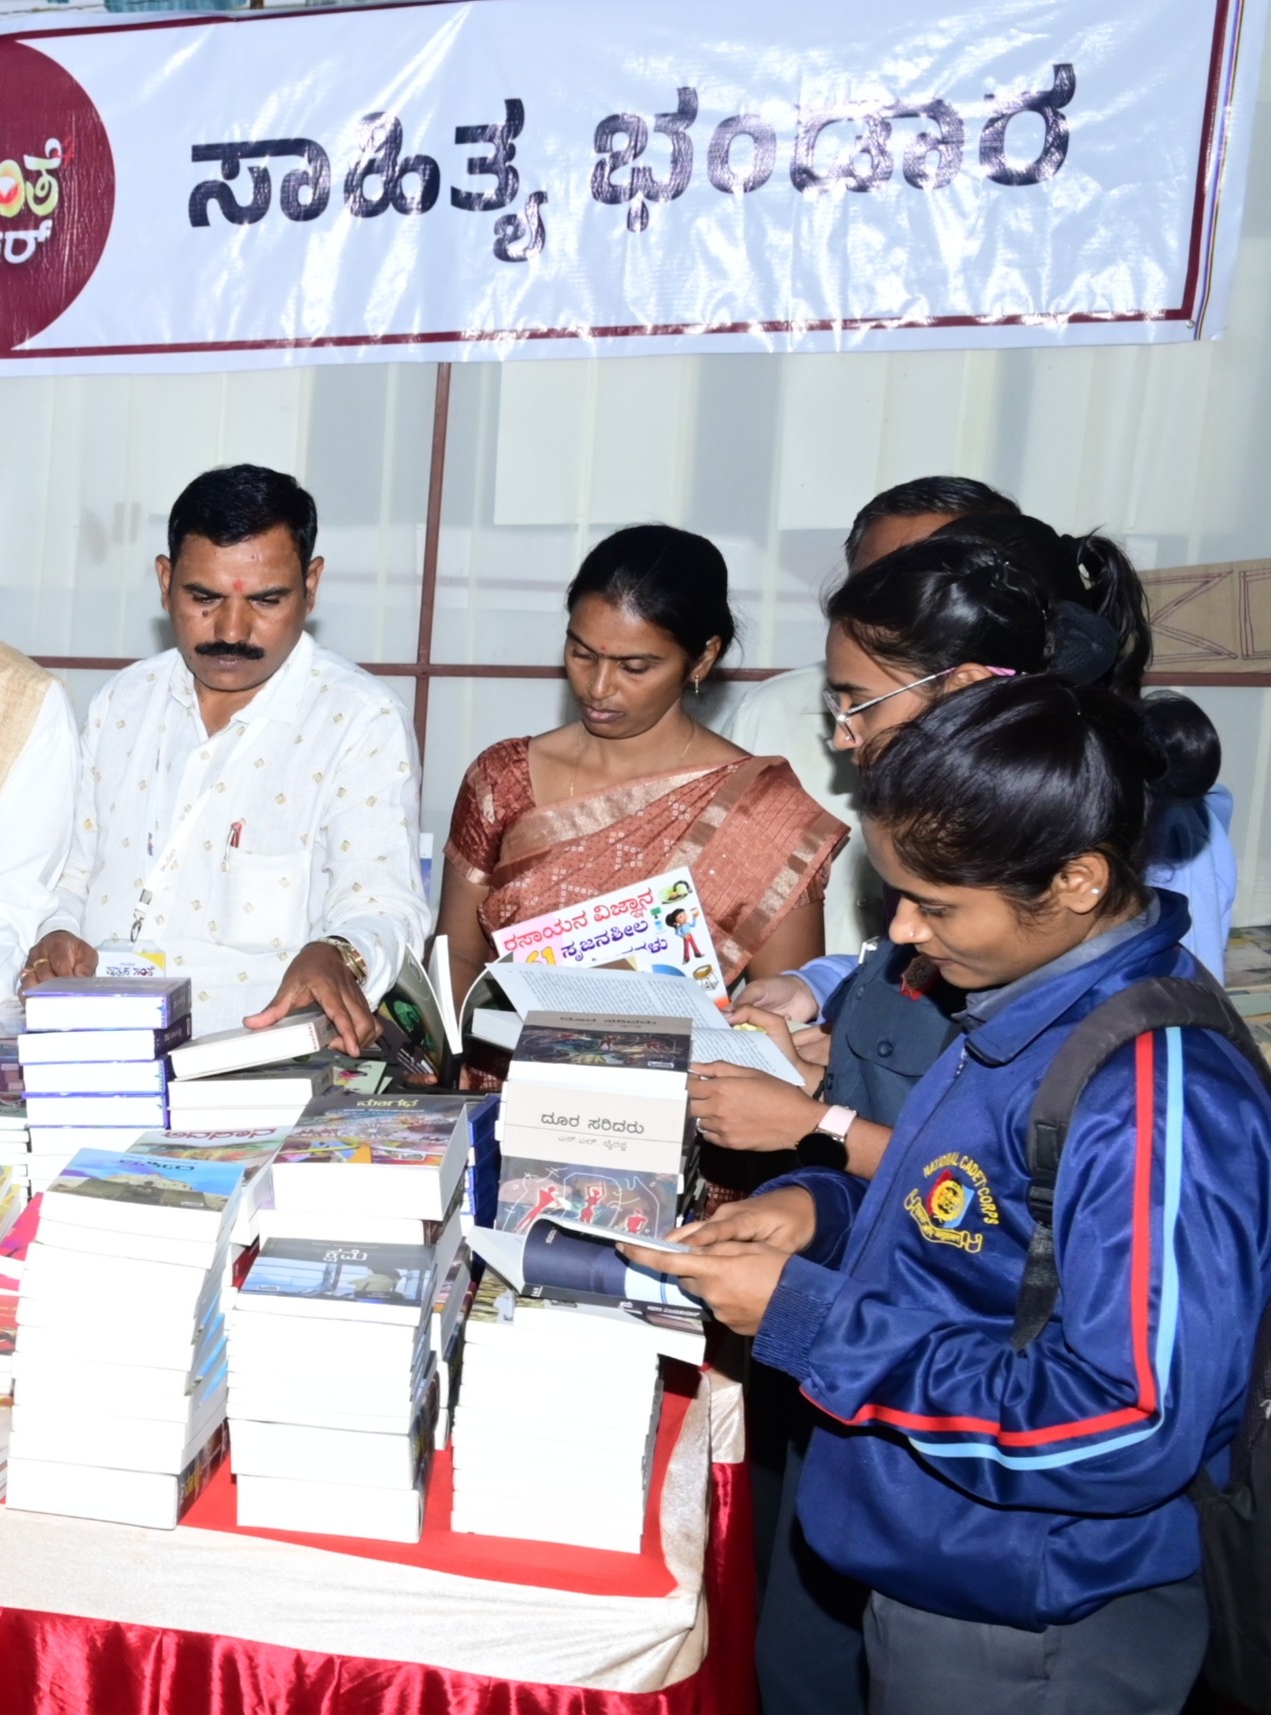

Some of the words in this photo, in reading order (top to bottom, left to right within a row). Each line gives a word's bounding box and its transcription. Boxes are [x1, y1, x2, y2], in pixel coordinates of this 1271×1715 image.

[188, 98, 548, 262] ಸಾಹಿತ್ಯ
[592, 63, 1075, 232] ಭಂಡಾರ
[504, 911, 588, 952] ರಸಾಯನ
[593, 888, 654, 921] ವಿಜ್ಞಾನ
[561, 920, 649, 962] ಸೃಜನಶೀಲ
[541, 1111, 581, 1128] ದೂರ
[587, 1116, 646, 1135] ಸರಿದರು
[977, 1187, 1000, 1225] CORPS
